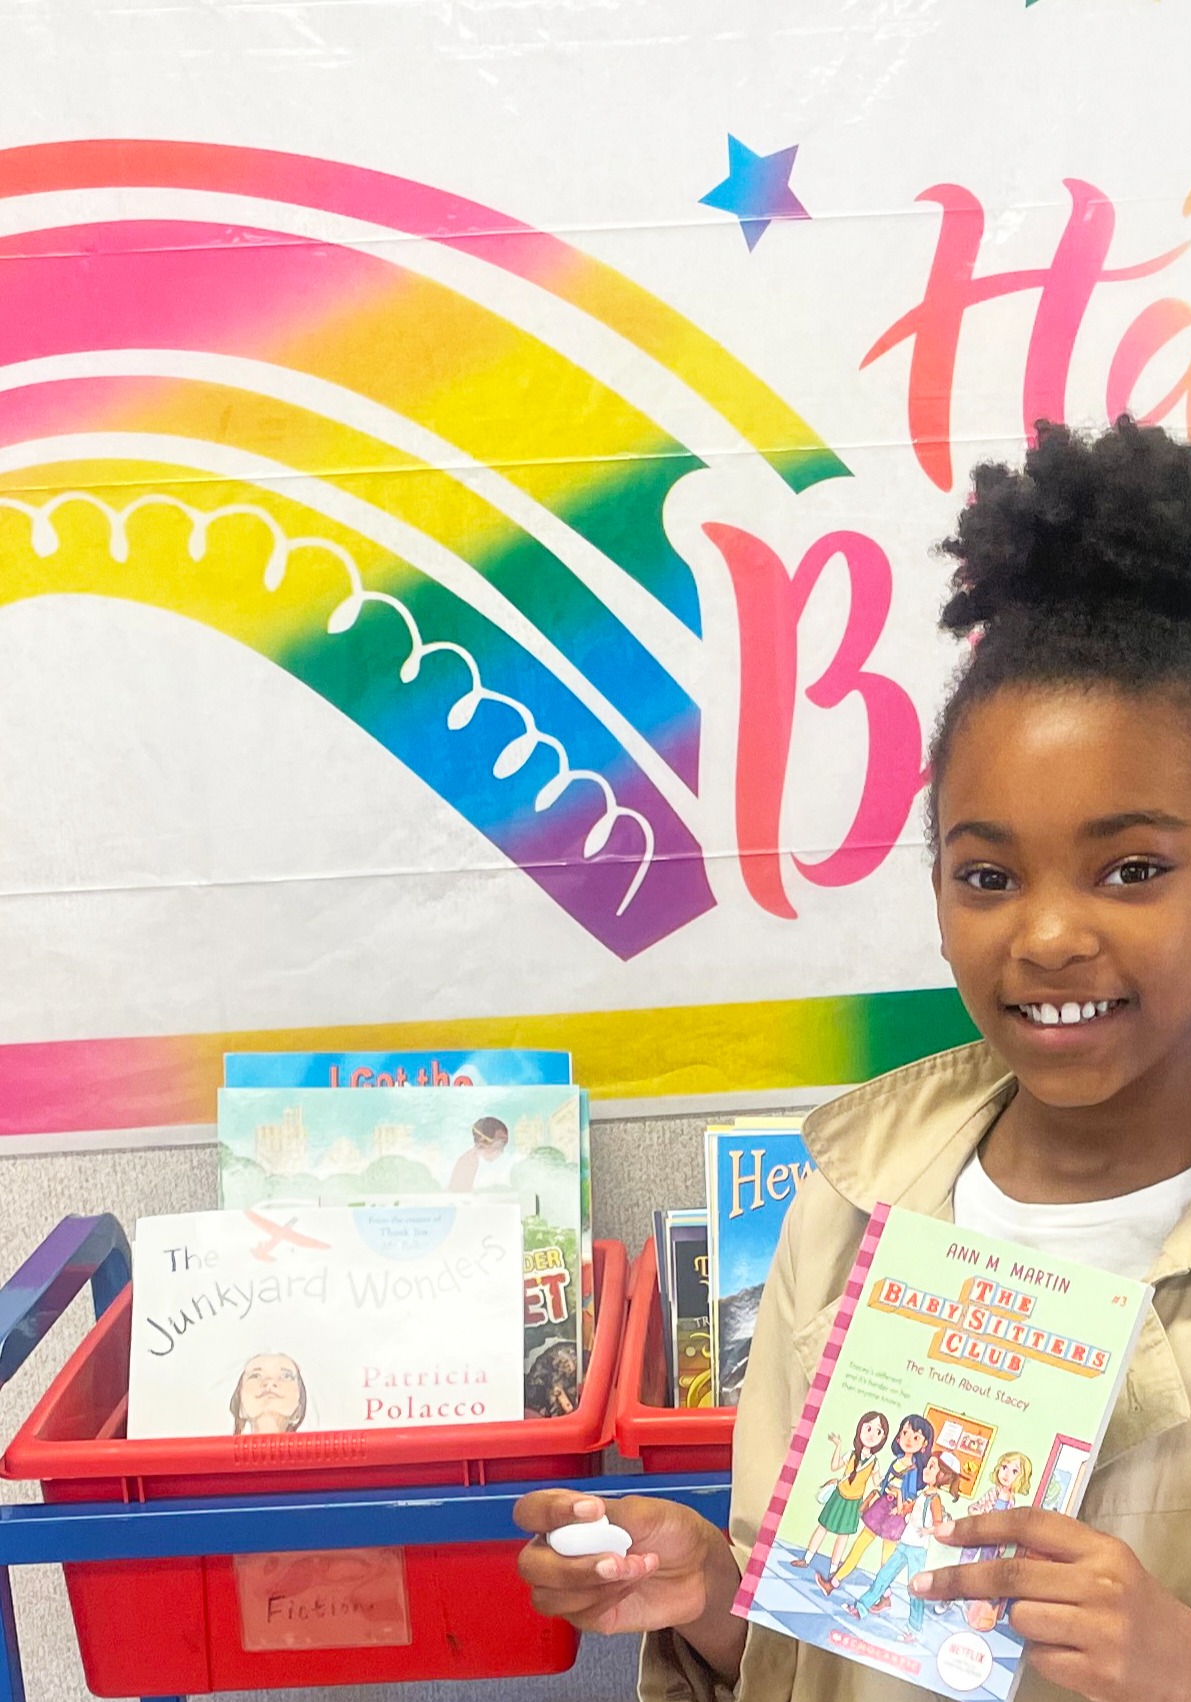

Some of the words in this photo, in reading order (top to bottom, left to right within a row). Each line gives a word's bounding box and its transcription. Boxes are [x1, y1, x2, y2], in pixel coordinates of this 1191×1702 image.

[164, 1246, 219, 1273] The
[946, 1242, 980, 1266] ANN
[1010, 1262, 1071, 1294] MARTIN
[147, 1266, 328, 1356] Junkyard
[347, 1234, 506, 1309] Wonders
[975, 1279, 1033, 1312] THE
[1111, 1295, 1128, 1308] #3
[945, 1332, 1021, 1373] CLUB
[362, 1366, 489, 1390] Patricia
[906, 1359, 924, 1375] The
[928, 1365, 955, 1386] Truth
[958, 1377, 991, 1398] About
[996, 1390, 1030, 1411] Stacey
[365, 1396, 486, 1421] Polacco
[950, 1643, 985, 1665] NETFLIX
